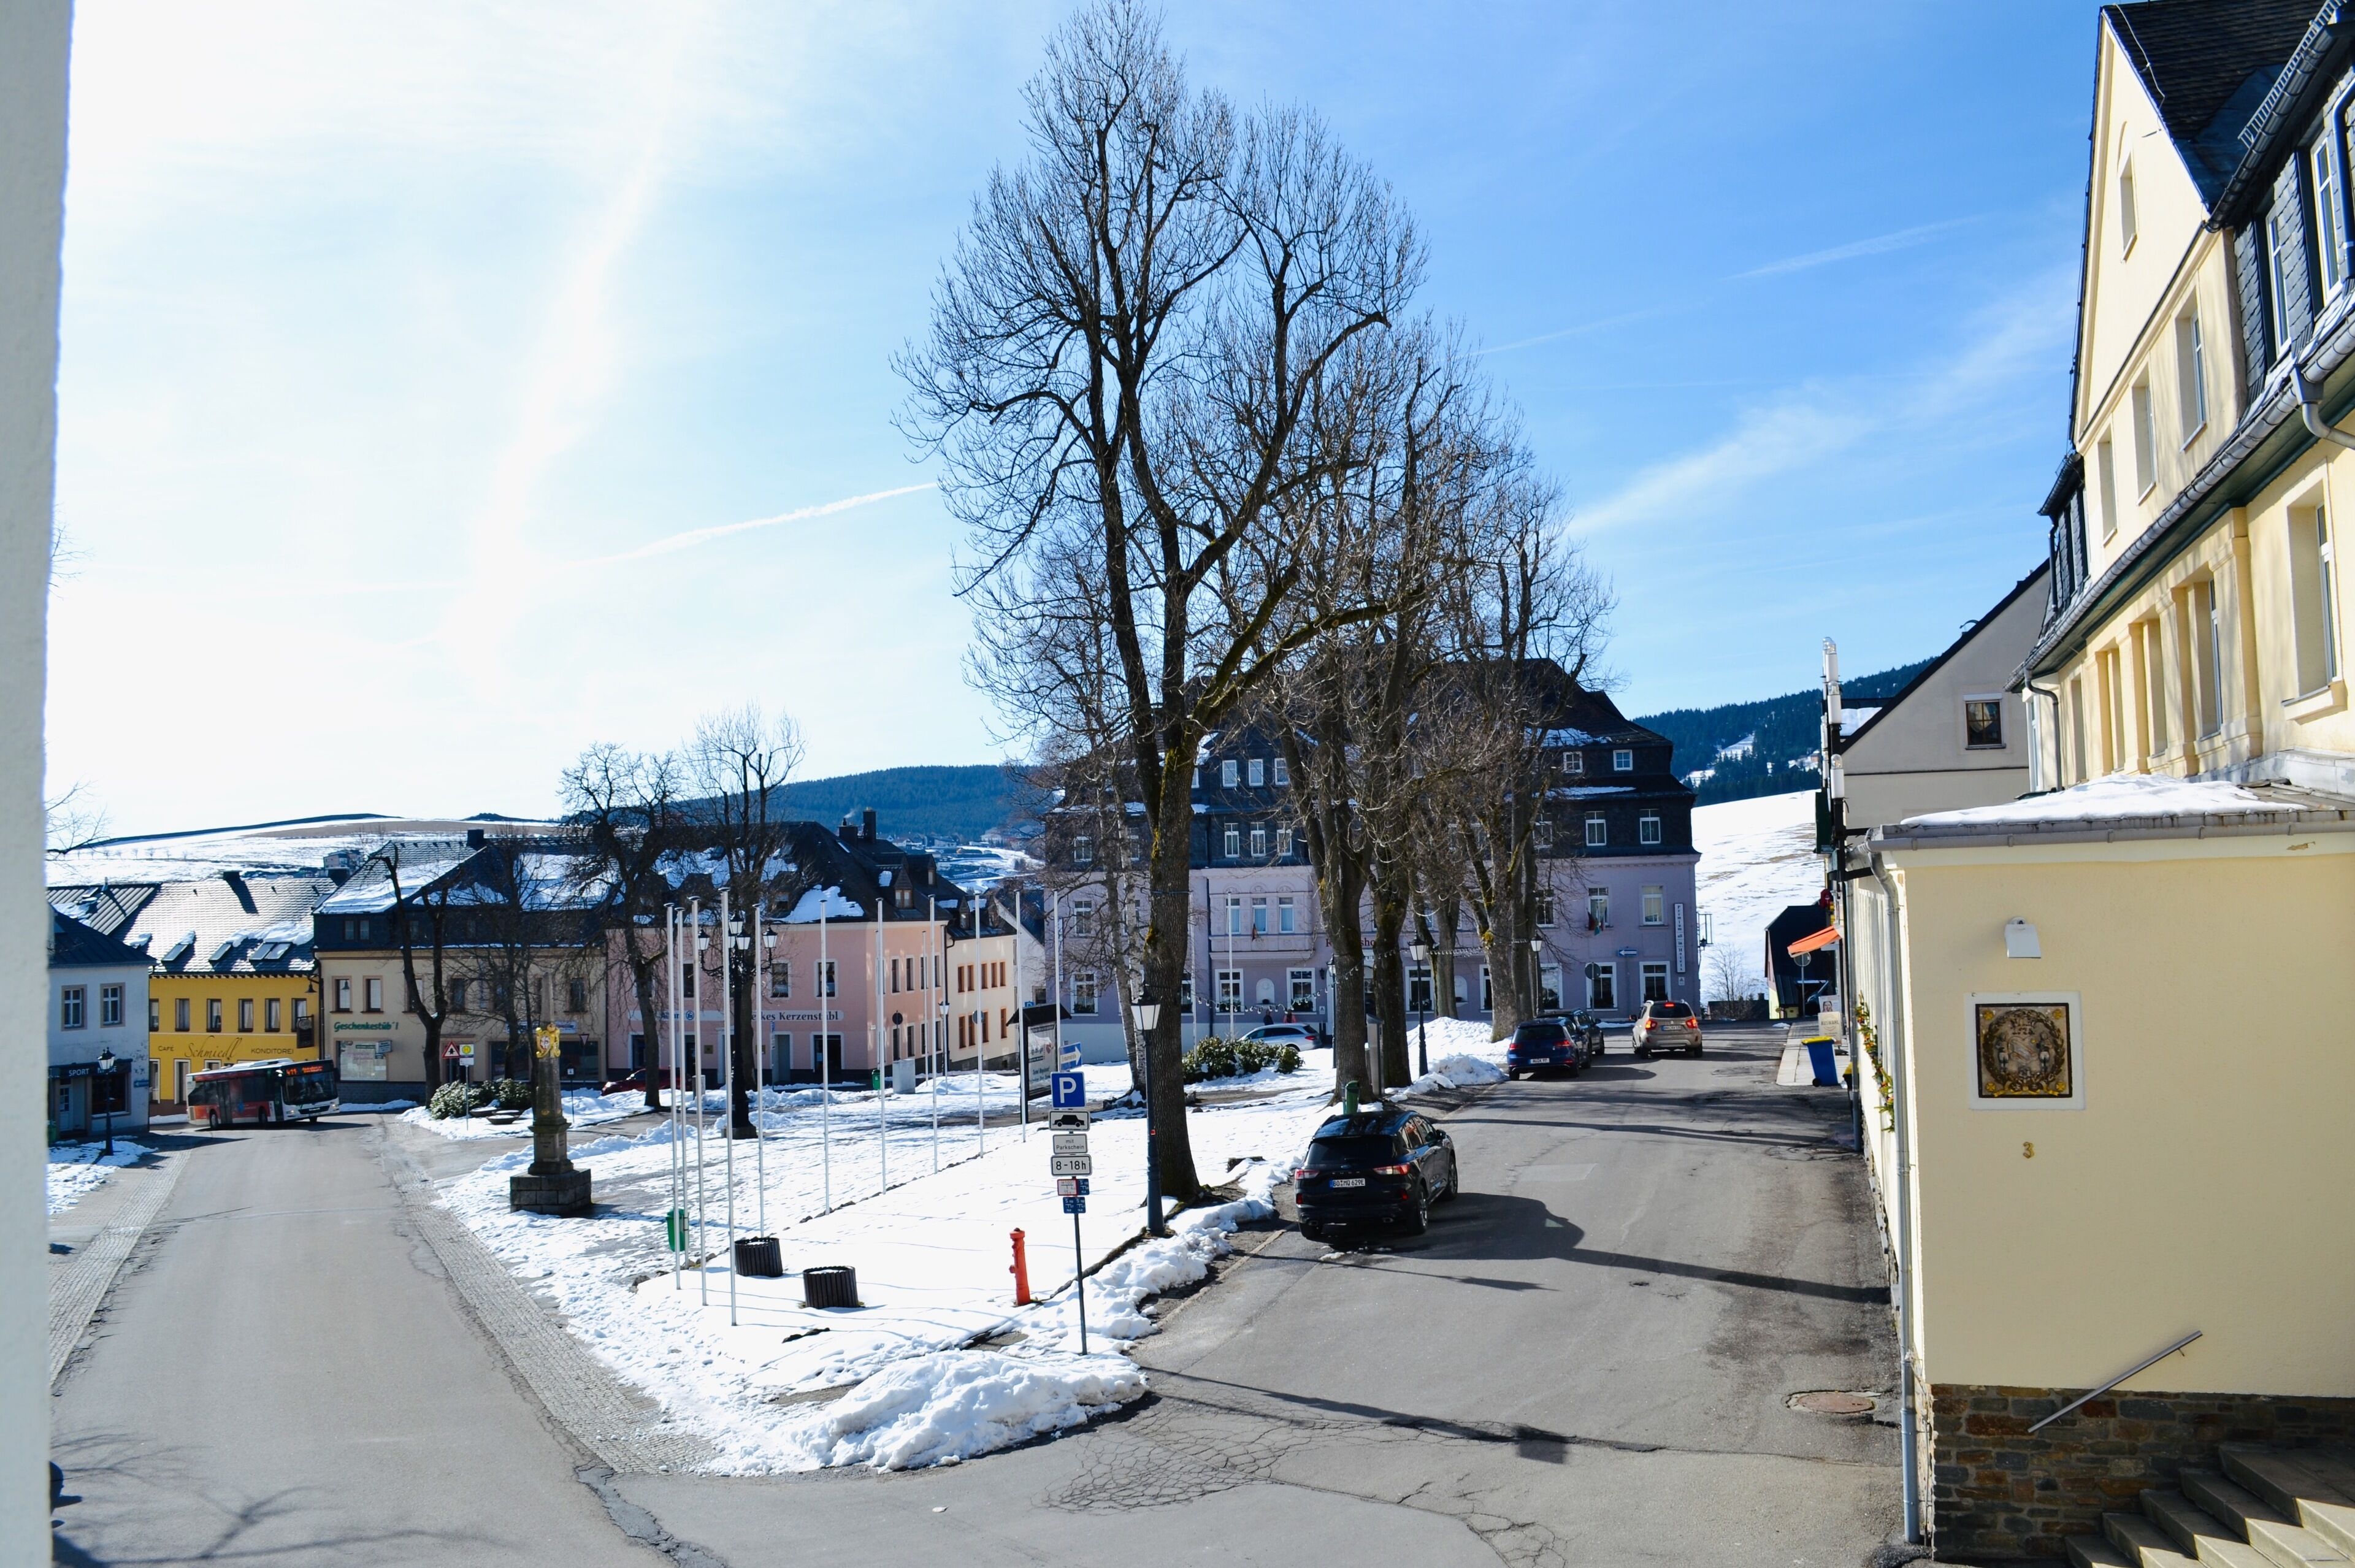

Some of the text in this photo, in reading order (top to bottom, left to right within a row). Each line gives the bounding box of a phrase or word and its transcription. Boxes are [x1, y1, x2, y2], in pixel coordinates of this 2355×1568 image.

[779, 1011, 838, 1020] Kerzenstbl
[184, 1035, 242, 1058] Schmiedl
[1059, 1077, 1076, 1103] P
[2023, 1142, 2035, 1158] 3
